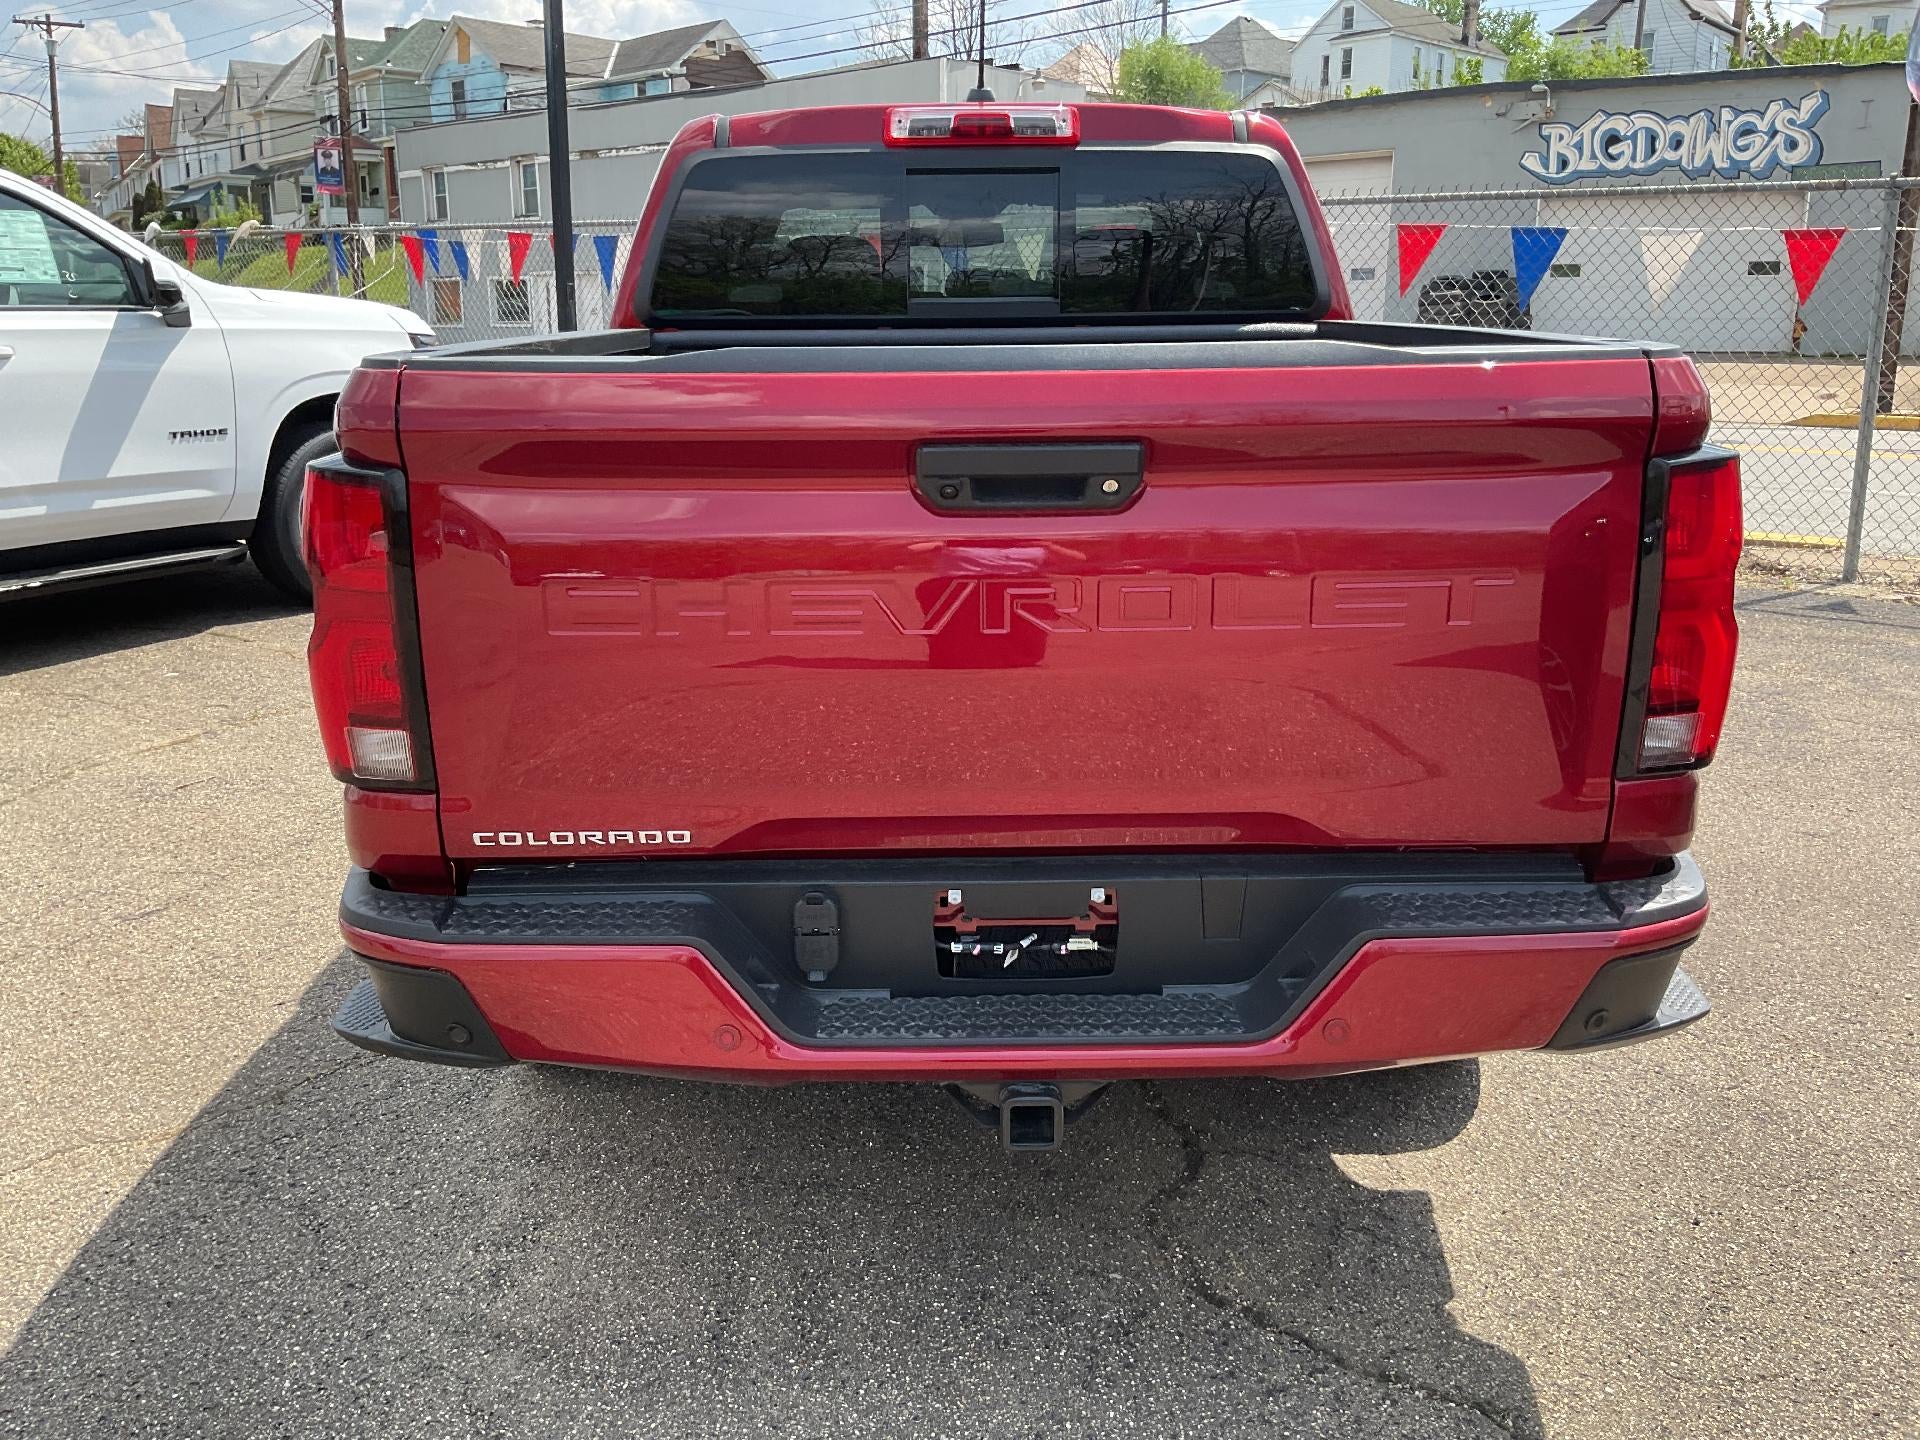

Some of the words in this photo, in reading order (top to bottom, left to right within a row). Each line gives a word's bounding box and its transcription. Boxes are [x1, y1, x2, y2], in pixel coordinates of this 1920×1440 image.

[168, 427, 229, 440] TAHOE
[541, 568, 1518, 635] CHEVROLET
[472, 830, 692, 846] COLORADO
